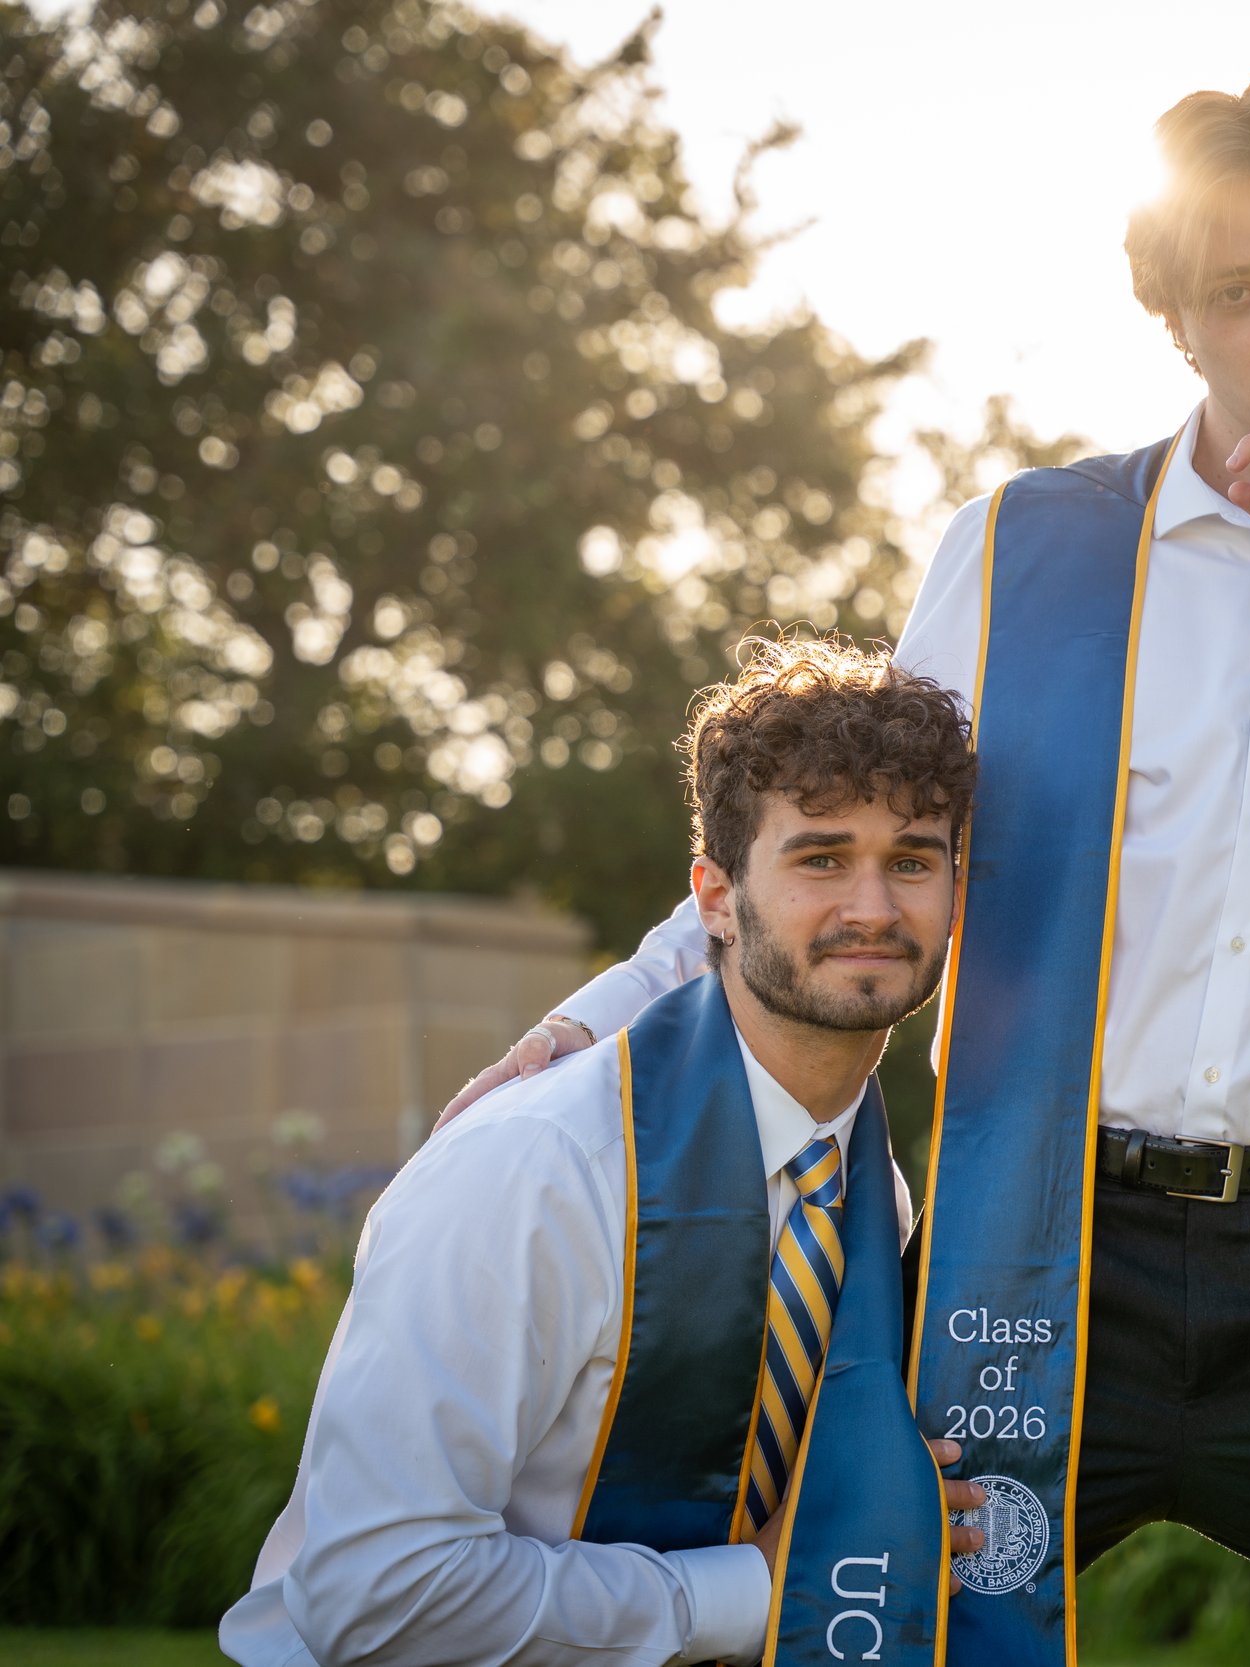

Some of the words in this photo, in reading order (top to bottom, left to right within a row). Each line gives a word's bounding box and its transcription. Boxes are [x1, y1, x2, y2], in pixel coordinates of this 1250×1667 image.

[948, 1307, 1052, 1344] Class
[979, 1356, 1018, 1391] of
[944, 1405, 1046, 1440] 2026
[982, 1481, 997, 1490] OF
[1010, 1488, 1042, 1545] CALIFORNIA
[954, 1557, 984, 1586] SANTA
[988, 1558, 1037, 1587] BARBARA
[826, 1552, 889, 1661] UC
